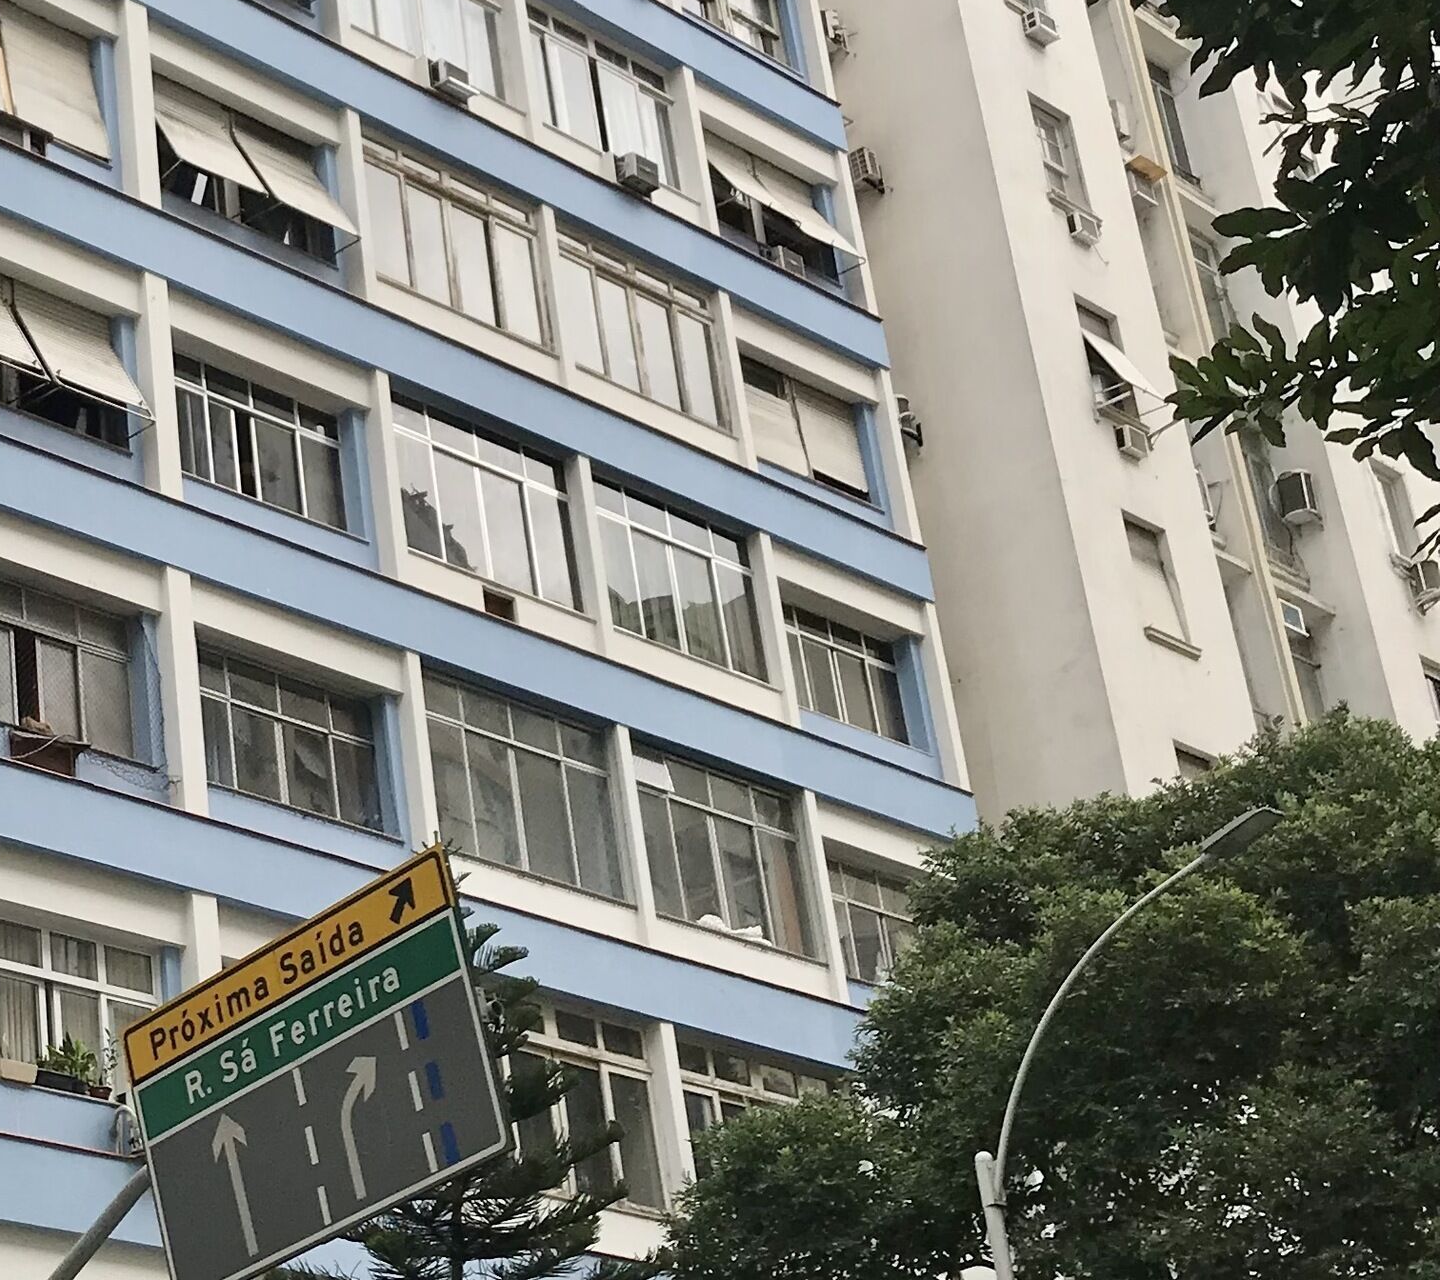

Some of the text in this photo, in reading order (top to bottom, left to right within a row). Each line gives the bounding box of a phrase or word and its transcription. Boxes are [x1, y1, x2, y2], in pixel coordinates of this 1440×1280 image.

[149, 921, 364, 1061] Próxima Saída
[184, 964, 401, 1104] R. Sá Ferreira
